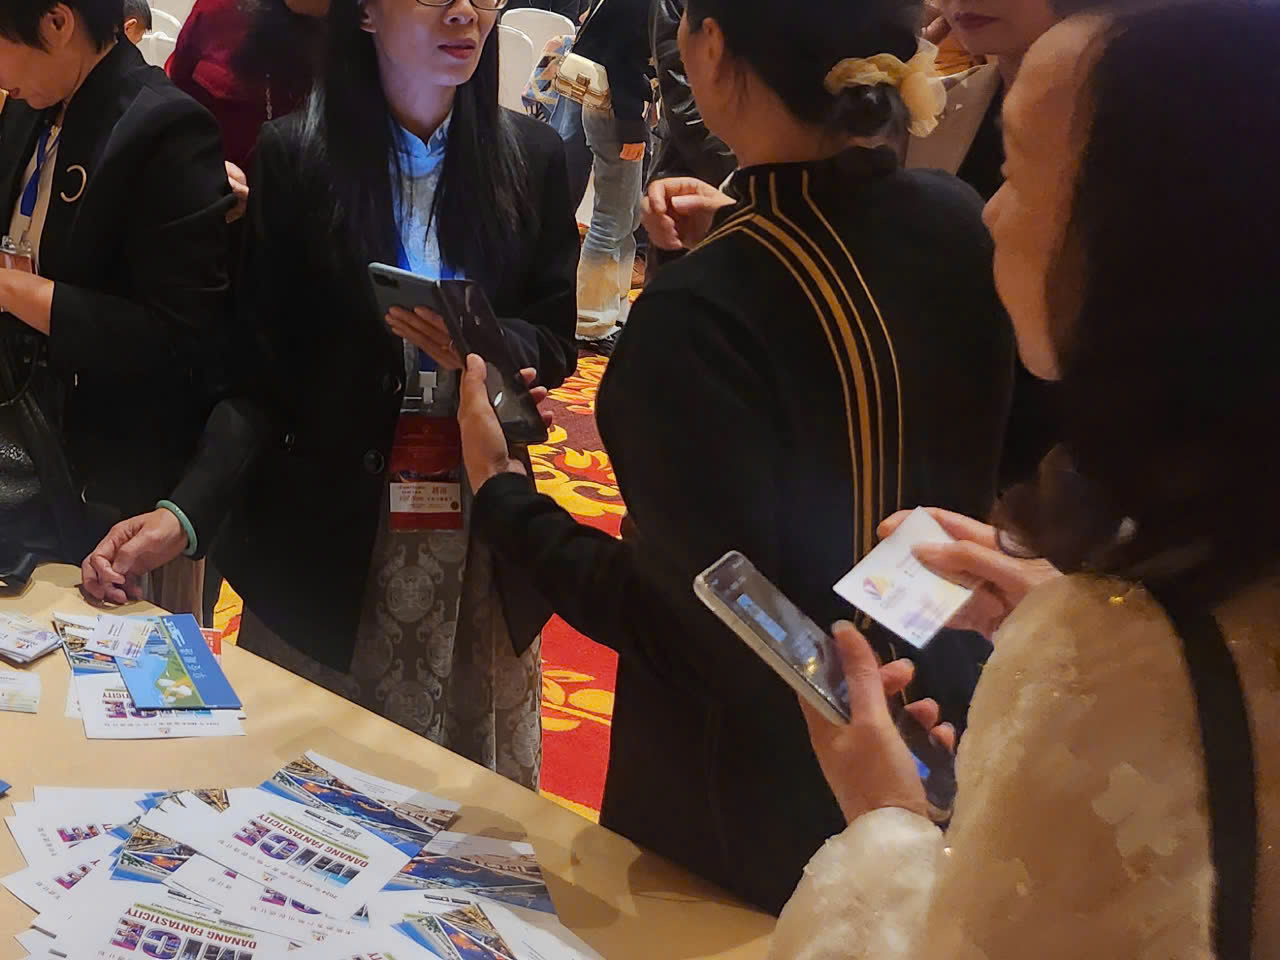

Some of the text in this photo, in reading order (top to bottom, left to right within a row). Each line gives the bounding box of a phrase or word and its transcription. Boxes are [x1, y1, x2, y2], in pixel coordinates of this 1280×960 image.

[257, 813, 324, 849] FANTASTICITY
[233, 819, 362, 887] MICE
[323, 845, 369, 869] DANANG
[125, 907, 257, 949] DANANG FANTASTICITY
